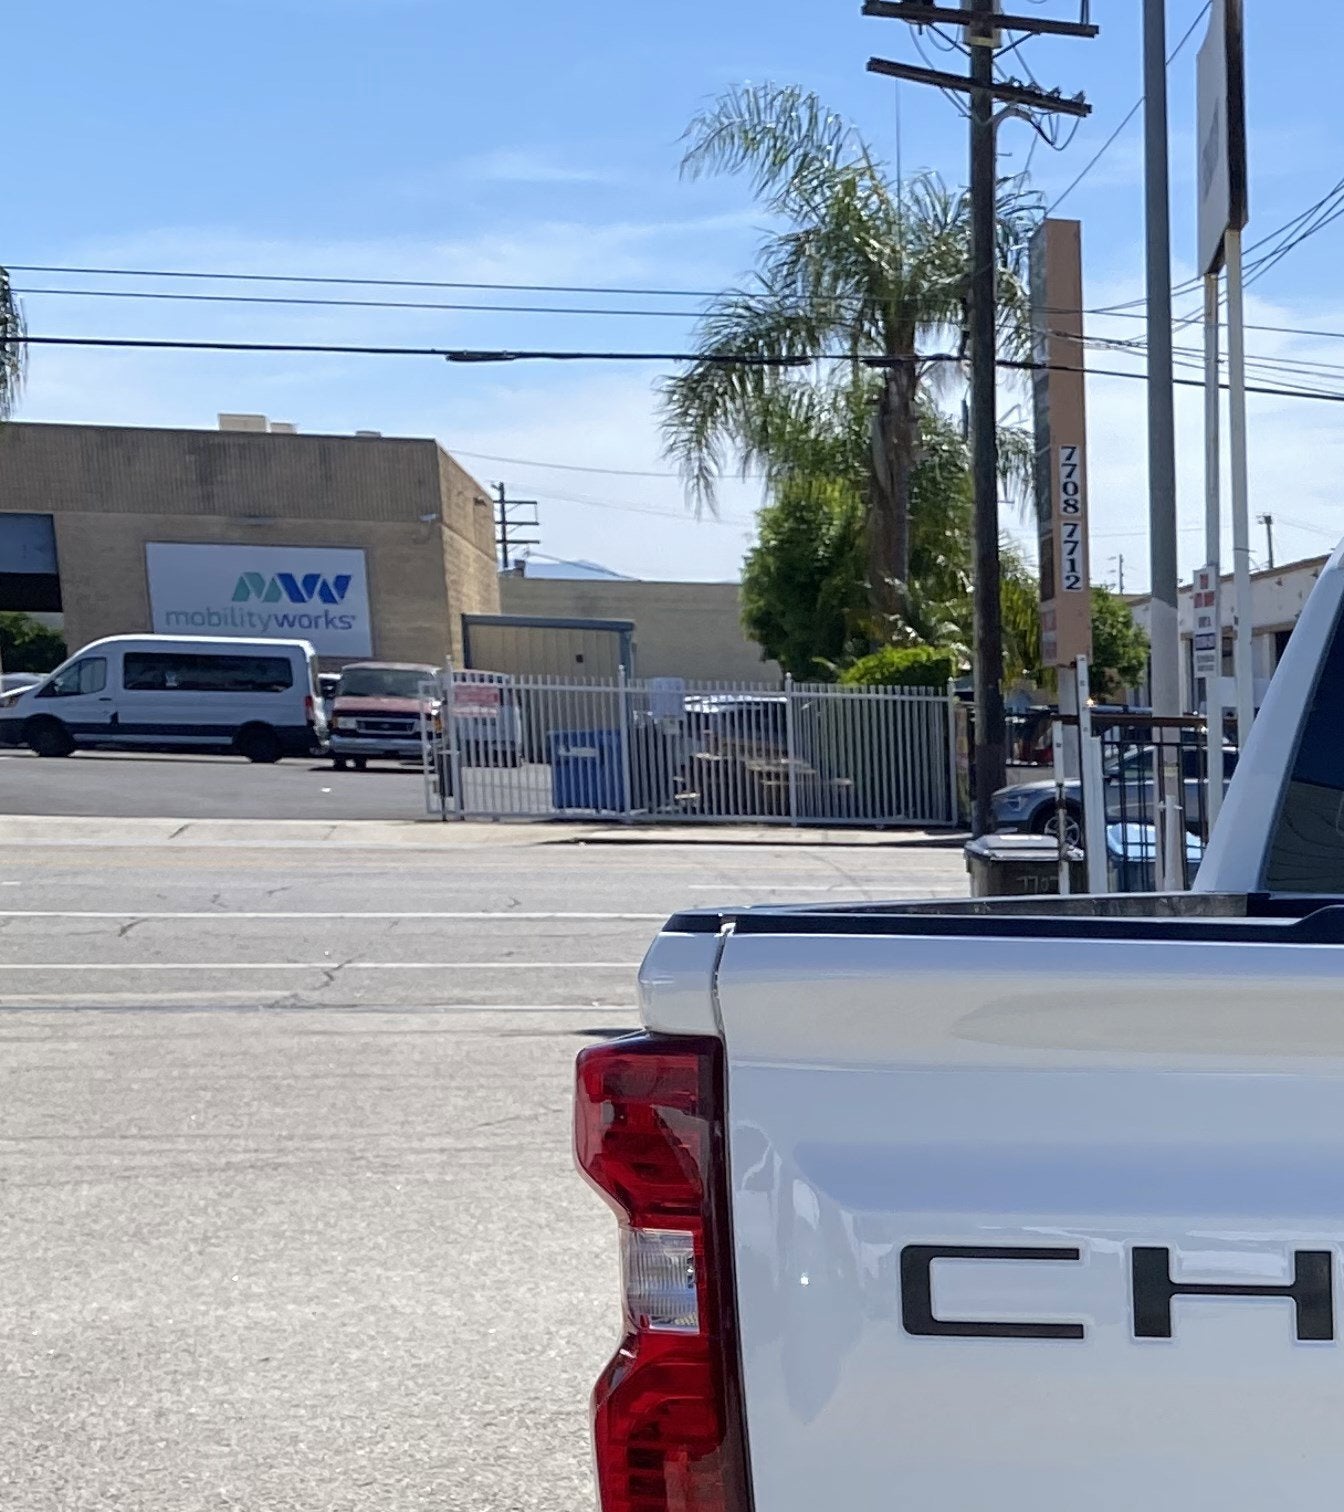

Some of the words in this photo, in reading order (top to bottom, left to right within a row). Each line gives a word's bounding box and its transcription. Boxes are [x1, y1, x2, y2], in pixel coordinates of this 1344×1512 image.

[1060, 446, 1080, 514] 7708
[1062, 522, 1082, 590] 7712
[165, 606, 353, 633] mobilityworks
